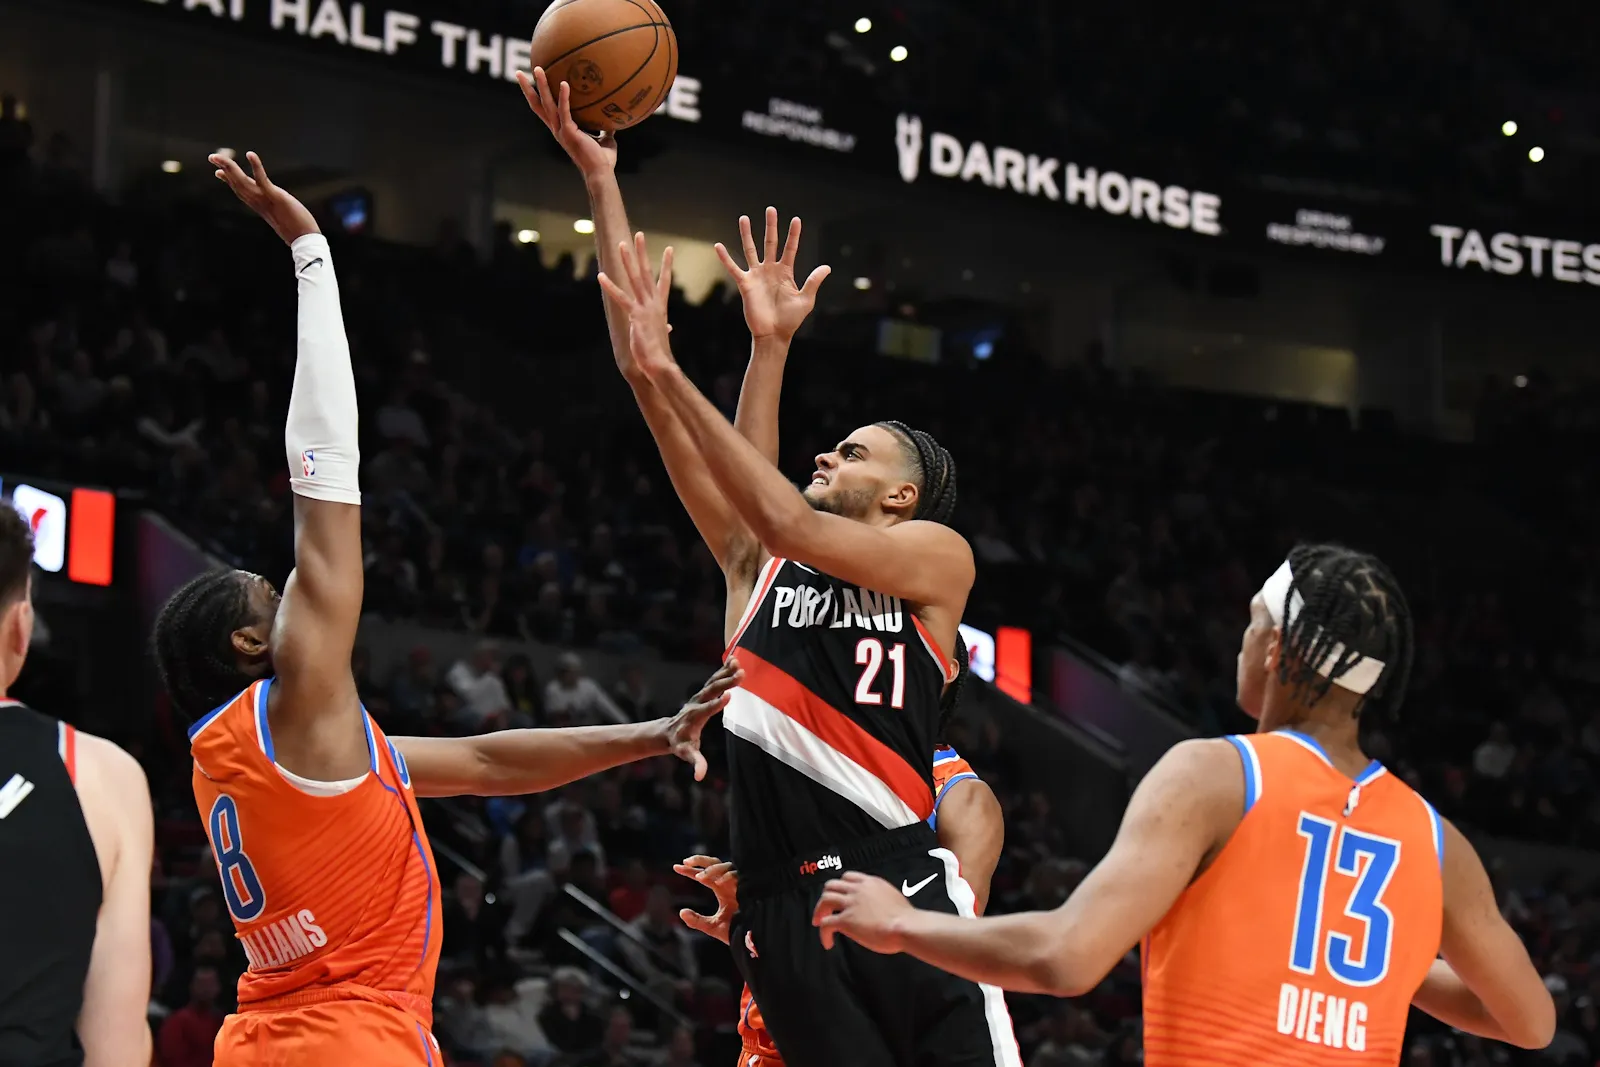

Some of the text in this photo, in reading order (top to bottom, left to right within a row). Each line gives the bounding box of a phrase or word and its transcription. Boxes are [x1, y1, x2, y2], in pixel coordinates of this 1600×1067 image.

[271, 0, 420, 54] HALF
[930, 132, 1222, 236] DARK HORSE
[771, 584, 903, 633] PORTLAND
[855, 637, 906, 709] 21
[208, 793, 266, 923] 8
[1288, 810, 1402, 988] 13
[1276, 982, 1369, 1053] DIENG
